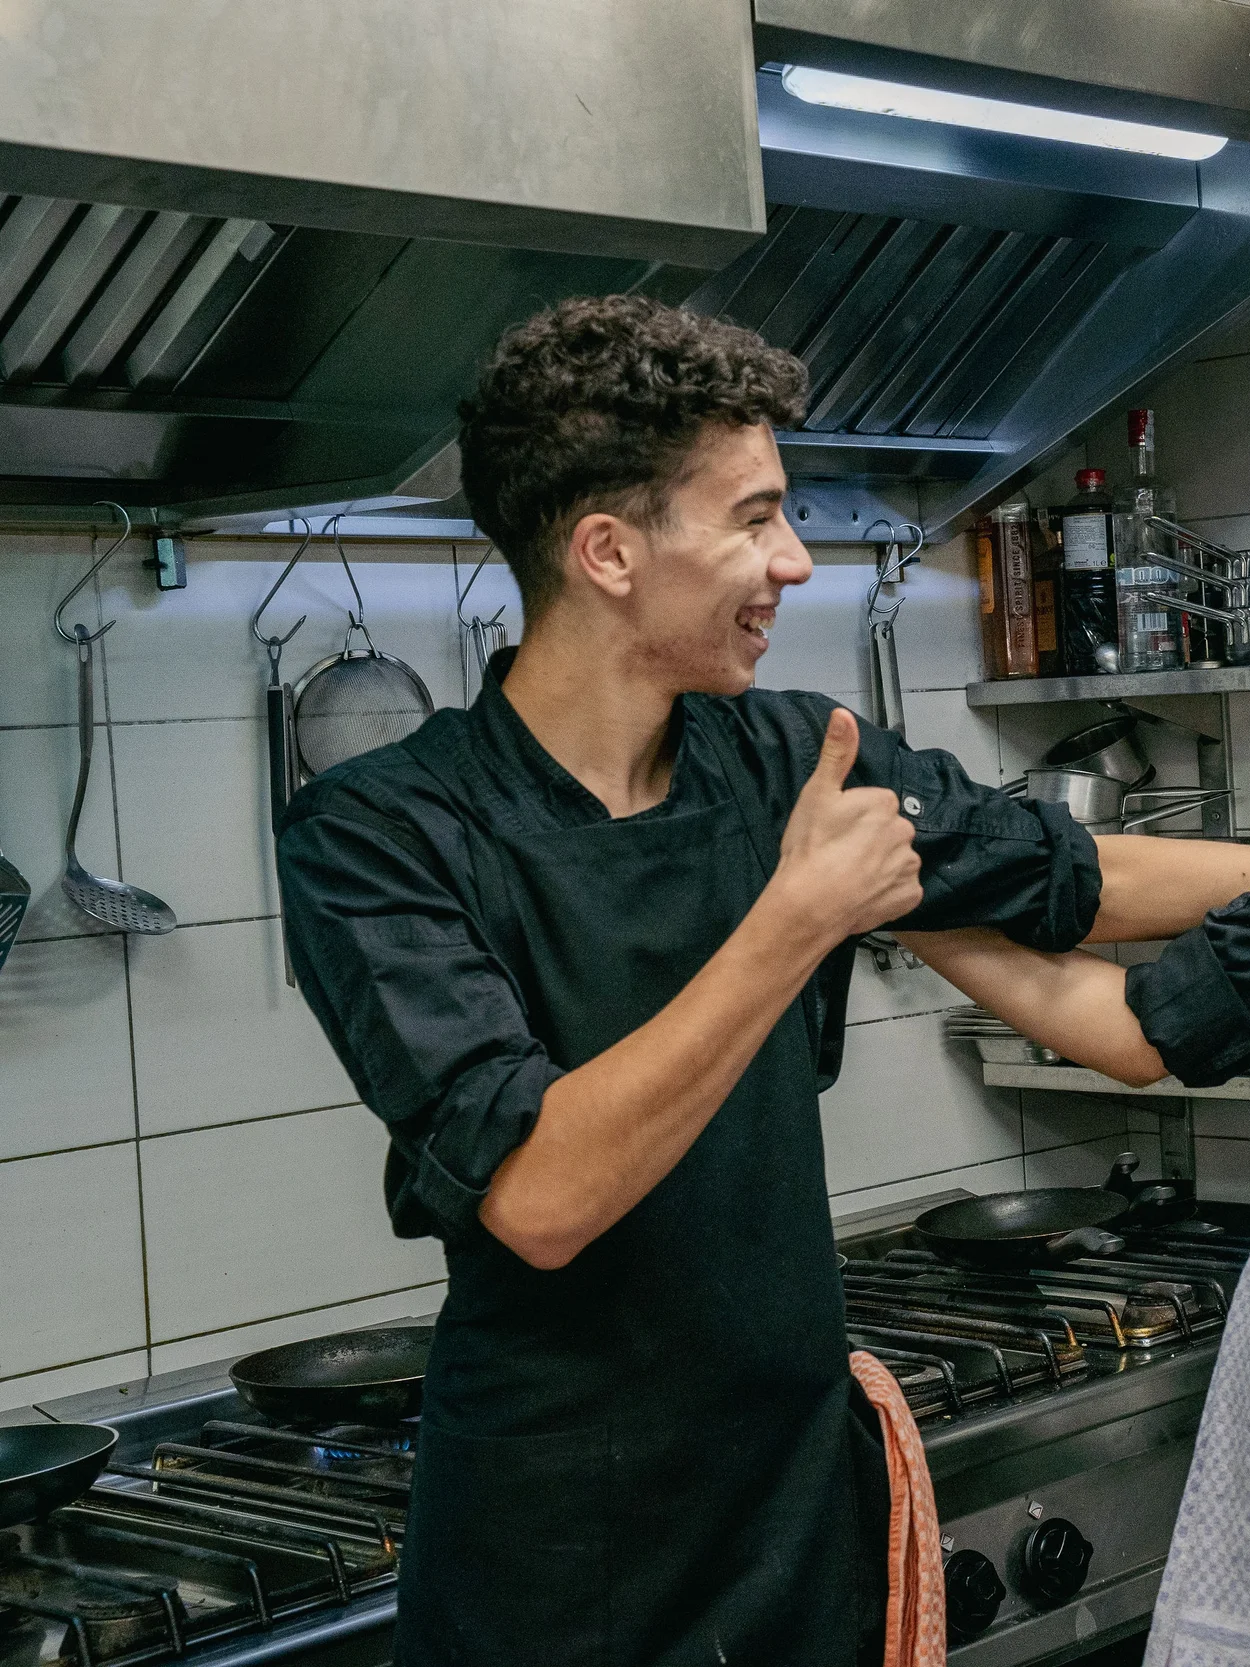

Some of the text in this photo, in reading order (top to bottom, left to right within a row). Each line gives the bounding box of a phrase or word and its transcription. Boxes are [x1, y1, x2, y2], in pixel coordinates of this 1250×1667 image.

[1010, 522, 1019, 546] 1882
[1012, 550, 1021, 576] SINCE
[1014, 581, 1023, 611] SPIRIT
